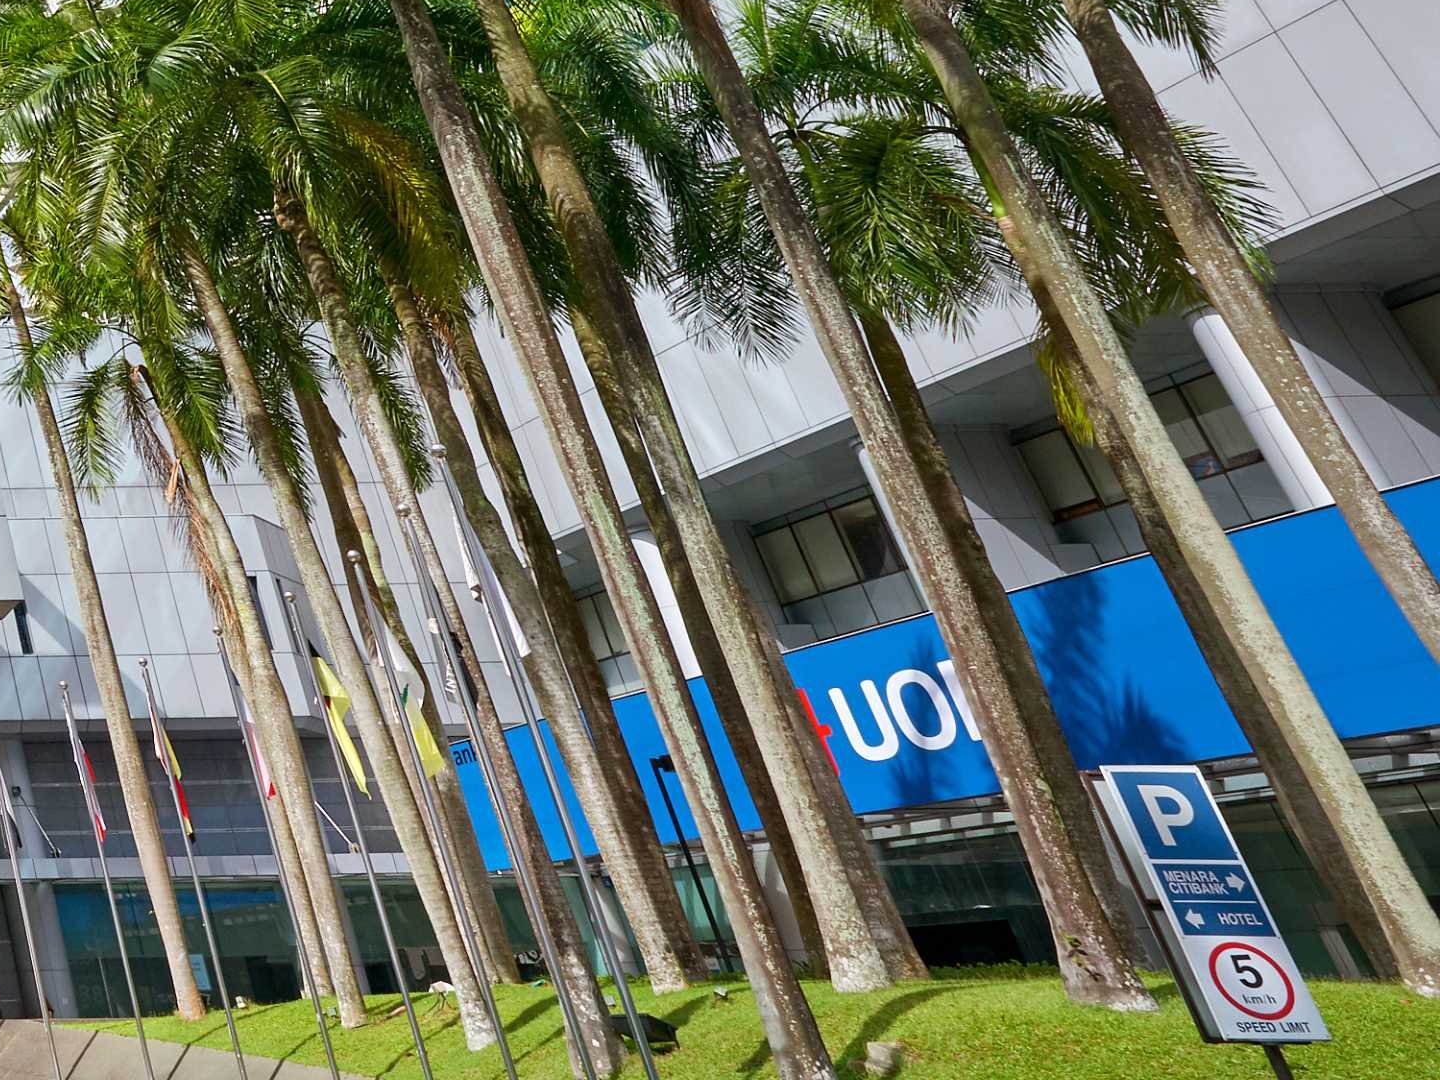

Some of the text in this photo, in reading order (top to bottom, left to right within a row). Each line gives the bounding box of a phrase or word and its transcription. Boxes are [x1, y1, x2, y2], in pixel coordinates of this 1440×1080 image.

[1136, 784, 1195, 847] P
[1162, 870, 1219, 882] MENARA
[1168, 882, 1230, 895] CITIBANK
[1217, 912, 1263, 926] HOTEL
[1230, 954, 1264, 989] 5
[1242, 994, 1277, 1005] km/h
[1236, 1021, 1311, 1033] SPEED LIMIT
